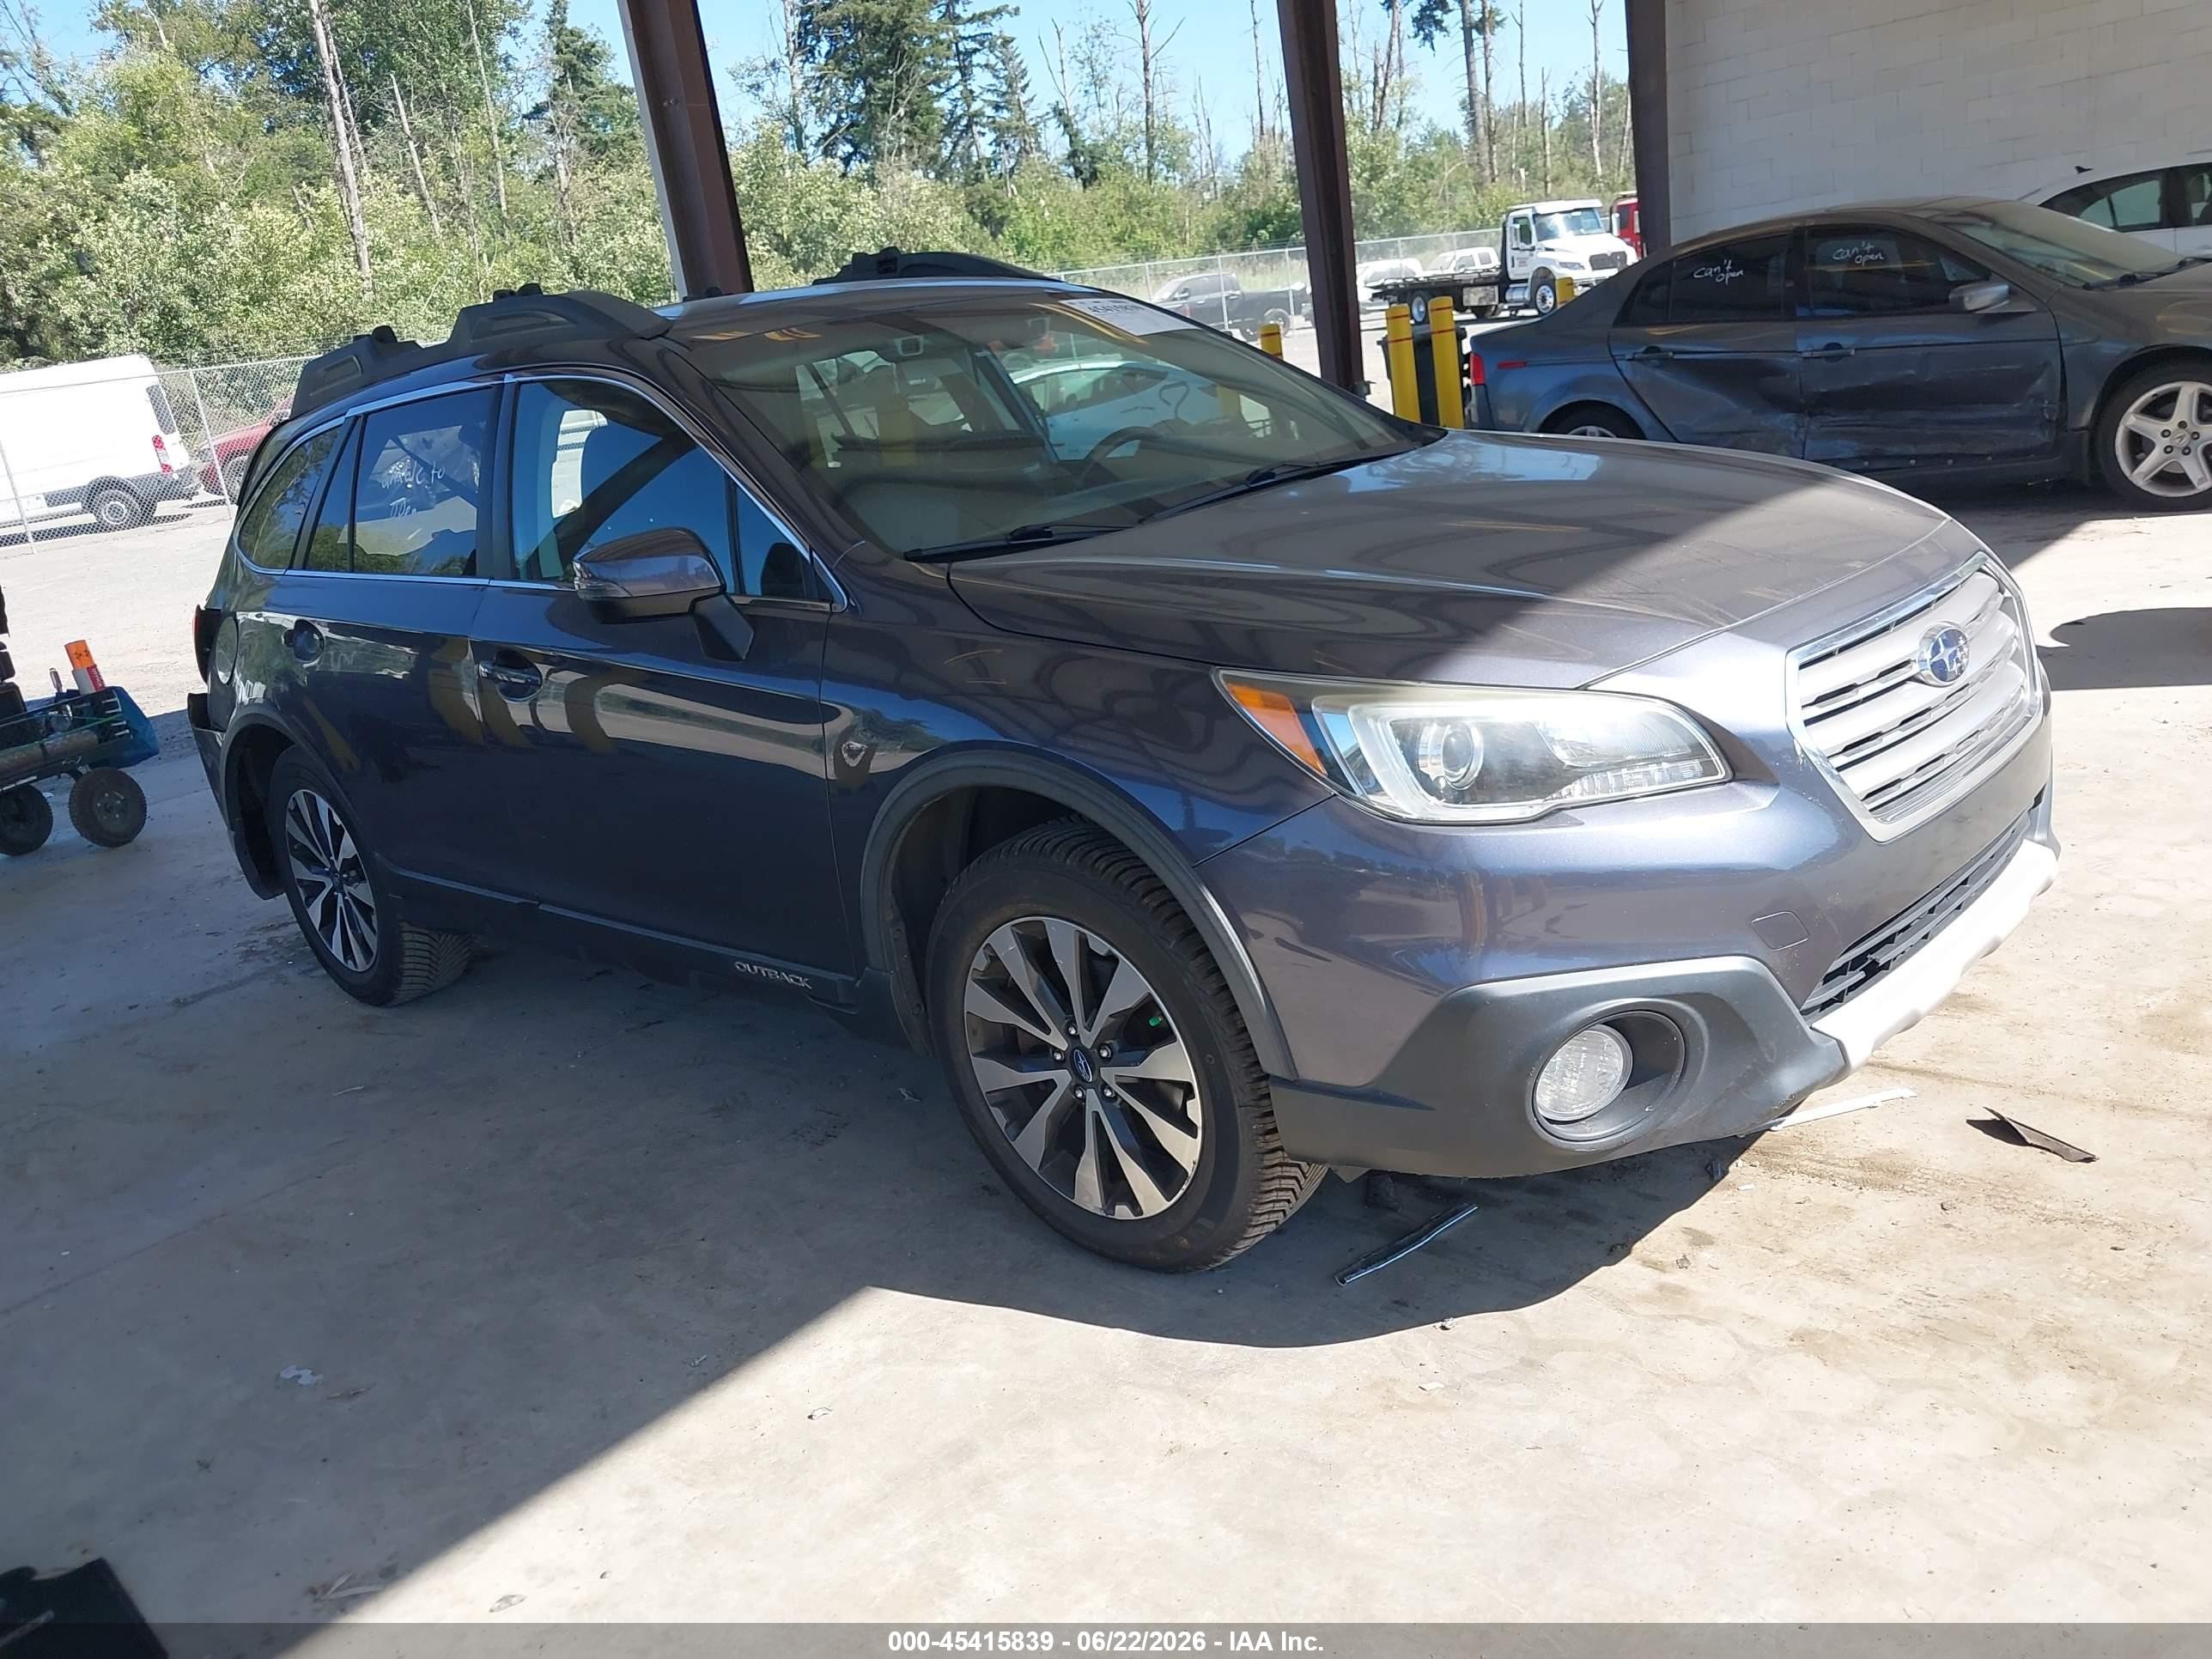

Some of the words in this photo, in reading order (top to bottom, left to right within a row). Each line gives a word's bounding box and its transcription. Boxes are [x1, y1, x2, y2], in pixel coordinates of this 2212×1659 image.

[1832, 240, 1875, 260] can't
[1854, 252, 1884, 267] open
[1693, 259, 1732, 278] can't
[431, 460, 446, 484] to
[734, 961, 813, 990] OUTBACK
